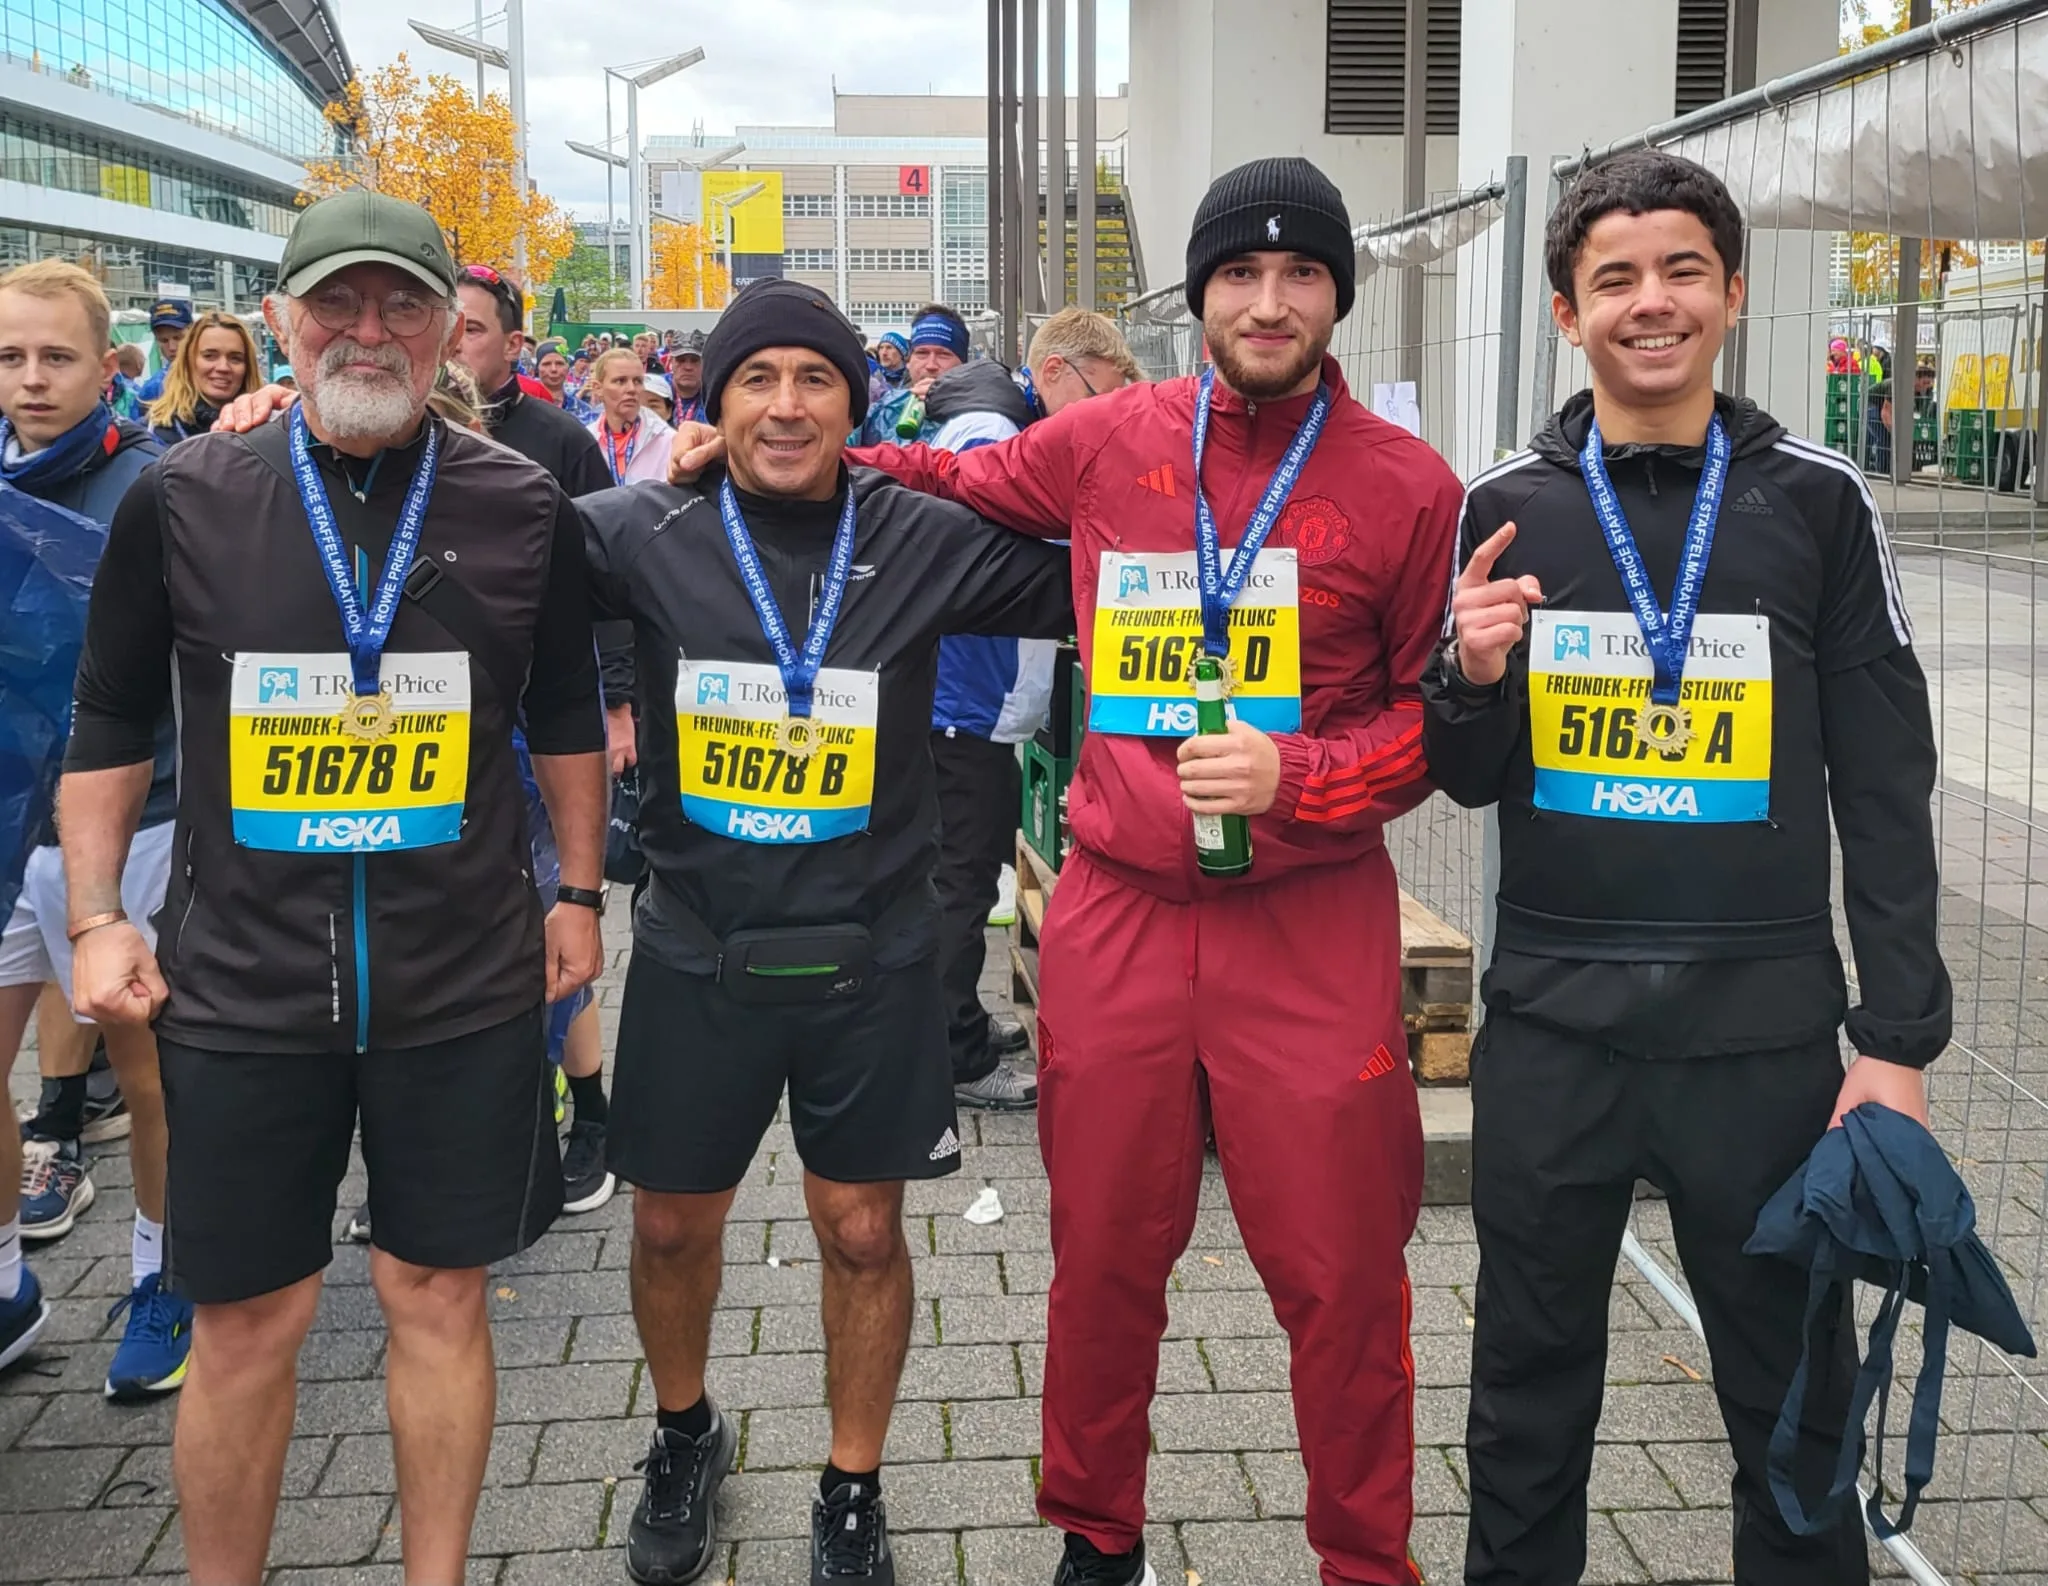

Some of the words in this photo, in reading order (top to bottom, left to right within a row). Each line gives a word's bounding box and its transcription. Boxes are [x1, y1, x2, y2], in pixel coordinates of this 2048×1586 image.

[906, 169, 923, 192] 4
[294, 428, 308, 464] ROWE
[300, 463, 321, 503] PRICE
[401, 427, 436, 540] STAFFELMARATHON
[1585, 428, 1626, 545] STAFFELMARATHON
[1702, 458, 1722, 500] PRICE
[723, 487, 736, 520] ROWE
[1221, 590, 1232, 599] T.
[1227, 550, 1250, 588] ROWE
[1244, 512, 1269, 549] PRICE
[1263, 400, 1326, 512] STAFFELMARATHON
[729, 519, 747, 553] PRICE
[313, 505, 362, 634] STAFFELMARATHON
[388, 541, 410, 581] PRICE
[1618, 546, 1643, 588] PRICE
[1670, 502, 1712, 640] STAFFELMARATHON
[1247, 572, 1275, 588] ice
[374, 583, 397, 623] ROWE
[742, 554, 793, 666] STAFFELMARATHON
[822, 582, 840, 617] PRICE
[1634, 589, 1659, 631] ROWE
[369, 627, 383, 636] T.
[808, 618, 829, 655] ROWE
[1651, 633, 1663, 646] T.
[1690, 636, 1745, 659] Price
[804, 658, 817, 667] T.
[1119, 636, 1230, 682] 5167
[1244, 636, 1271, 682] D
[310, 674, 392, 696] T.Re
[395, 674, 447, 694] Price
[813, 687, 856, 708] Price
[1147, 703, 1237, 731] HO
[1704, 712, 1734, 764] A
[263, 745, 397, 795] 51678
[410, 742, 440, 792] C
[703, 741, 809, 795] 51678
[820, 753, 848, 796] B
[1591, 782, 1698, 816] HOKA
[297, 816, 402, 847] HOKA
[727, 809, 813, 839] HOKA
